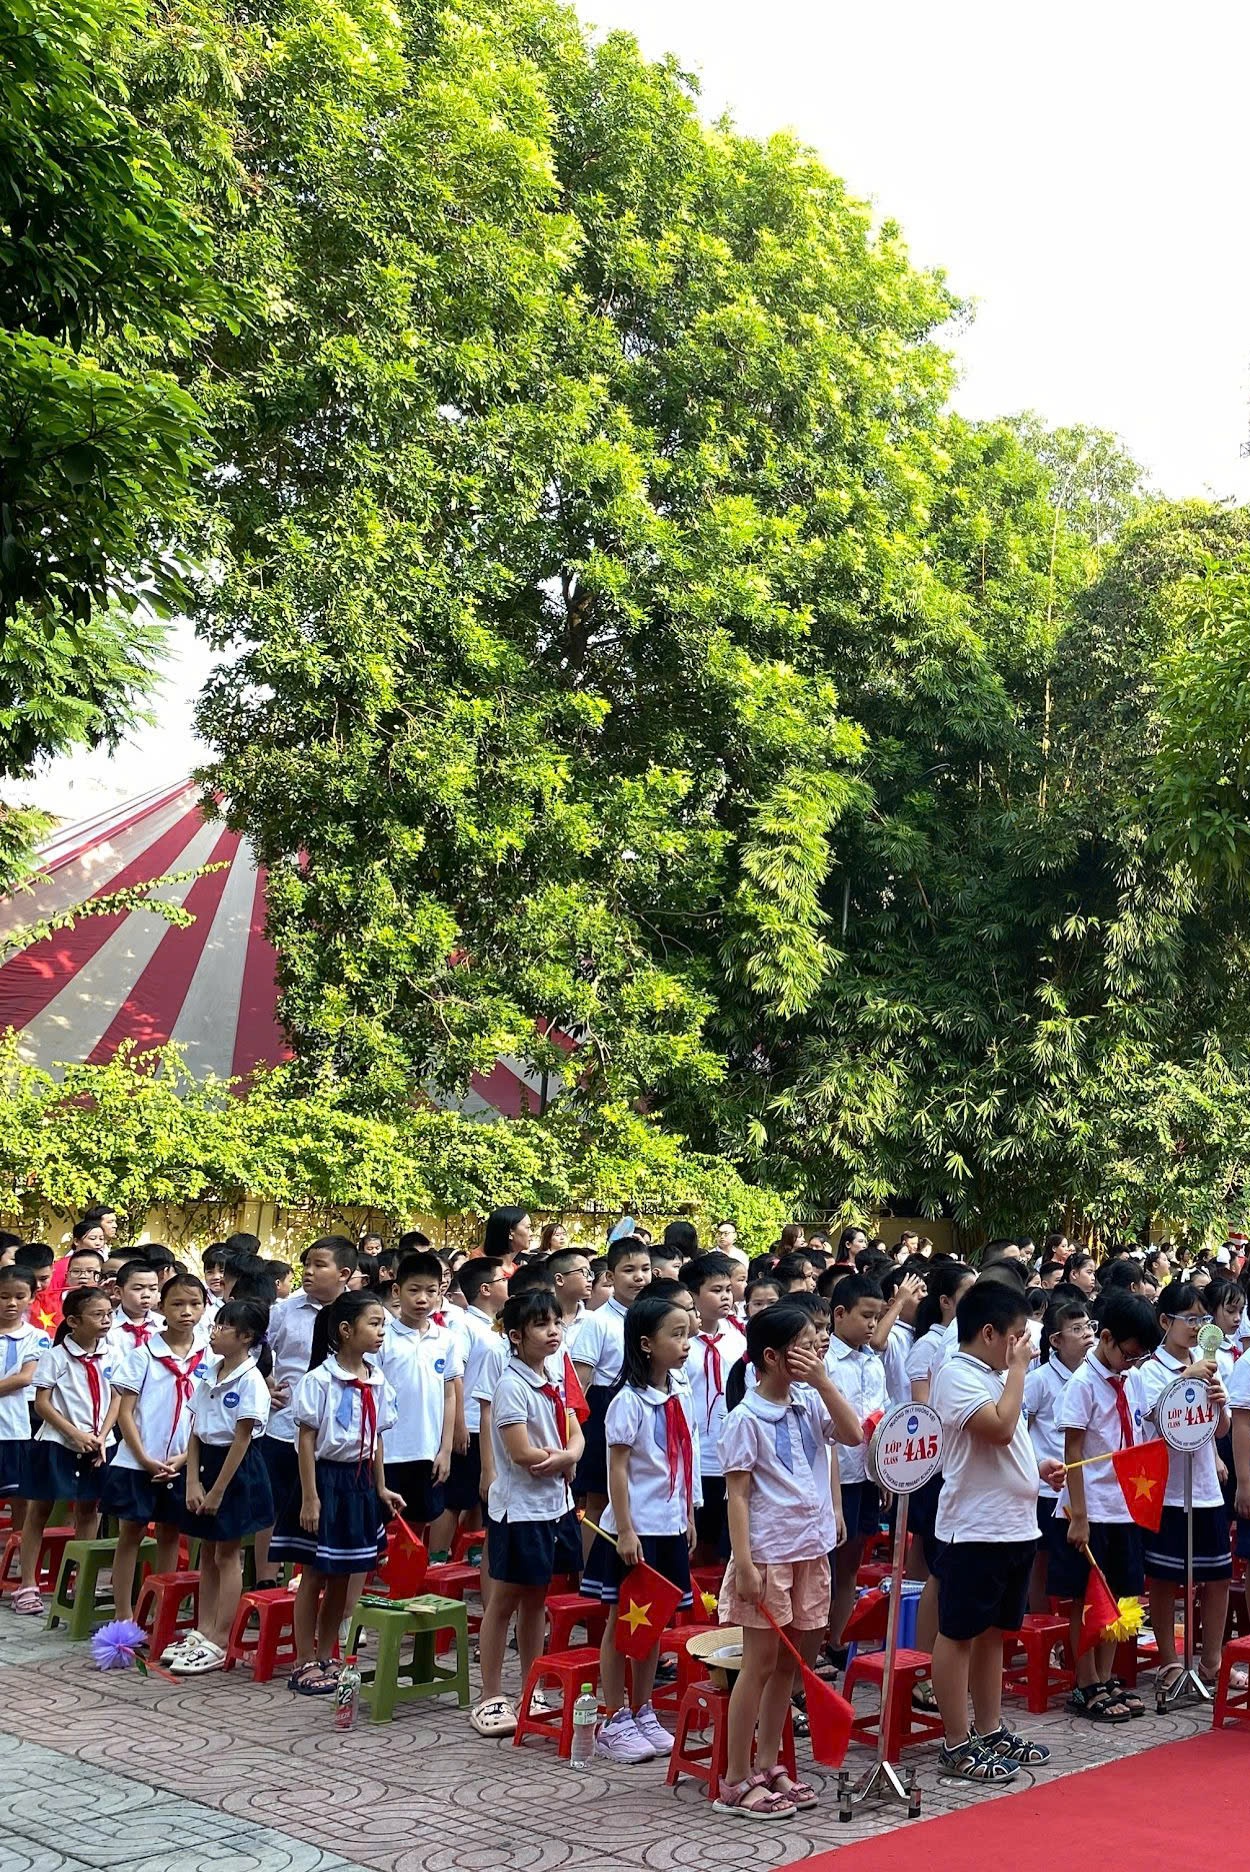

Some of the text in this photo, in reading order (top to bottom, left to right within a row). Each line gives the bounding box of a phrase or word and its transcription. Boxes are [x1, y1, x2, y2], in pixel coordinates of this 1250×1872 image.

[1184, 1403, 1215, 1426] 4A4
[885, 1434, 938, 1463] LỚP 4A5
[883, 1455, 899, 1466] CLASS
[338, 1685, 353, 1704] C2
